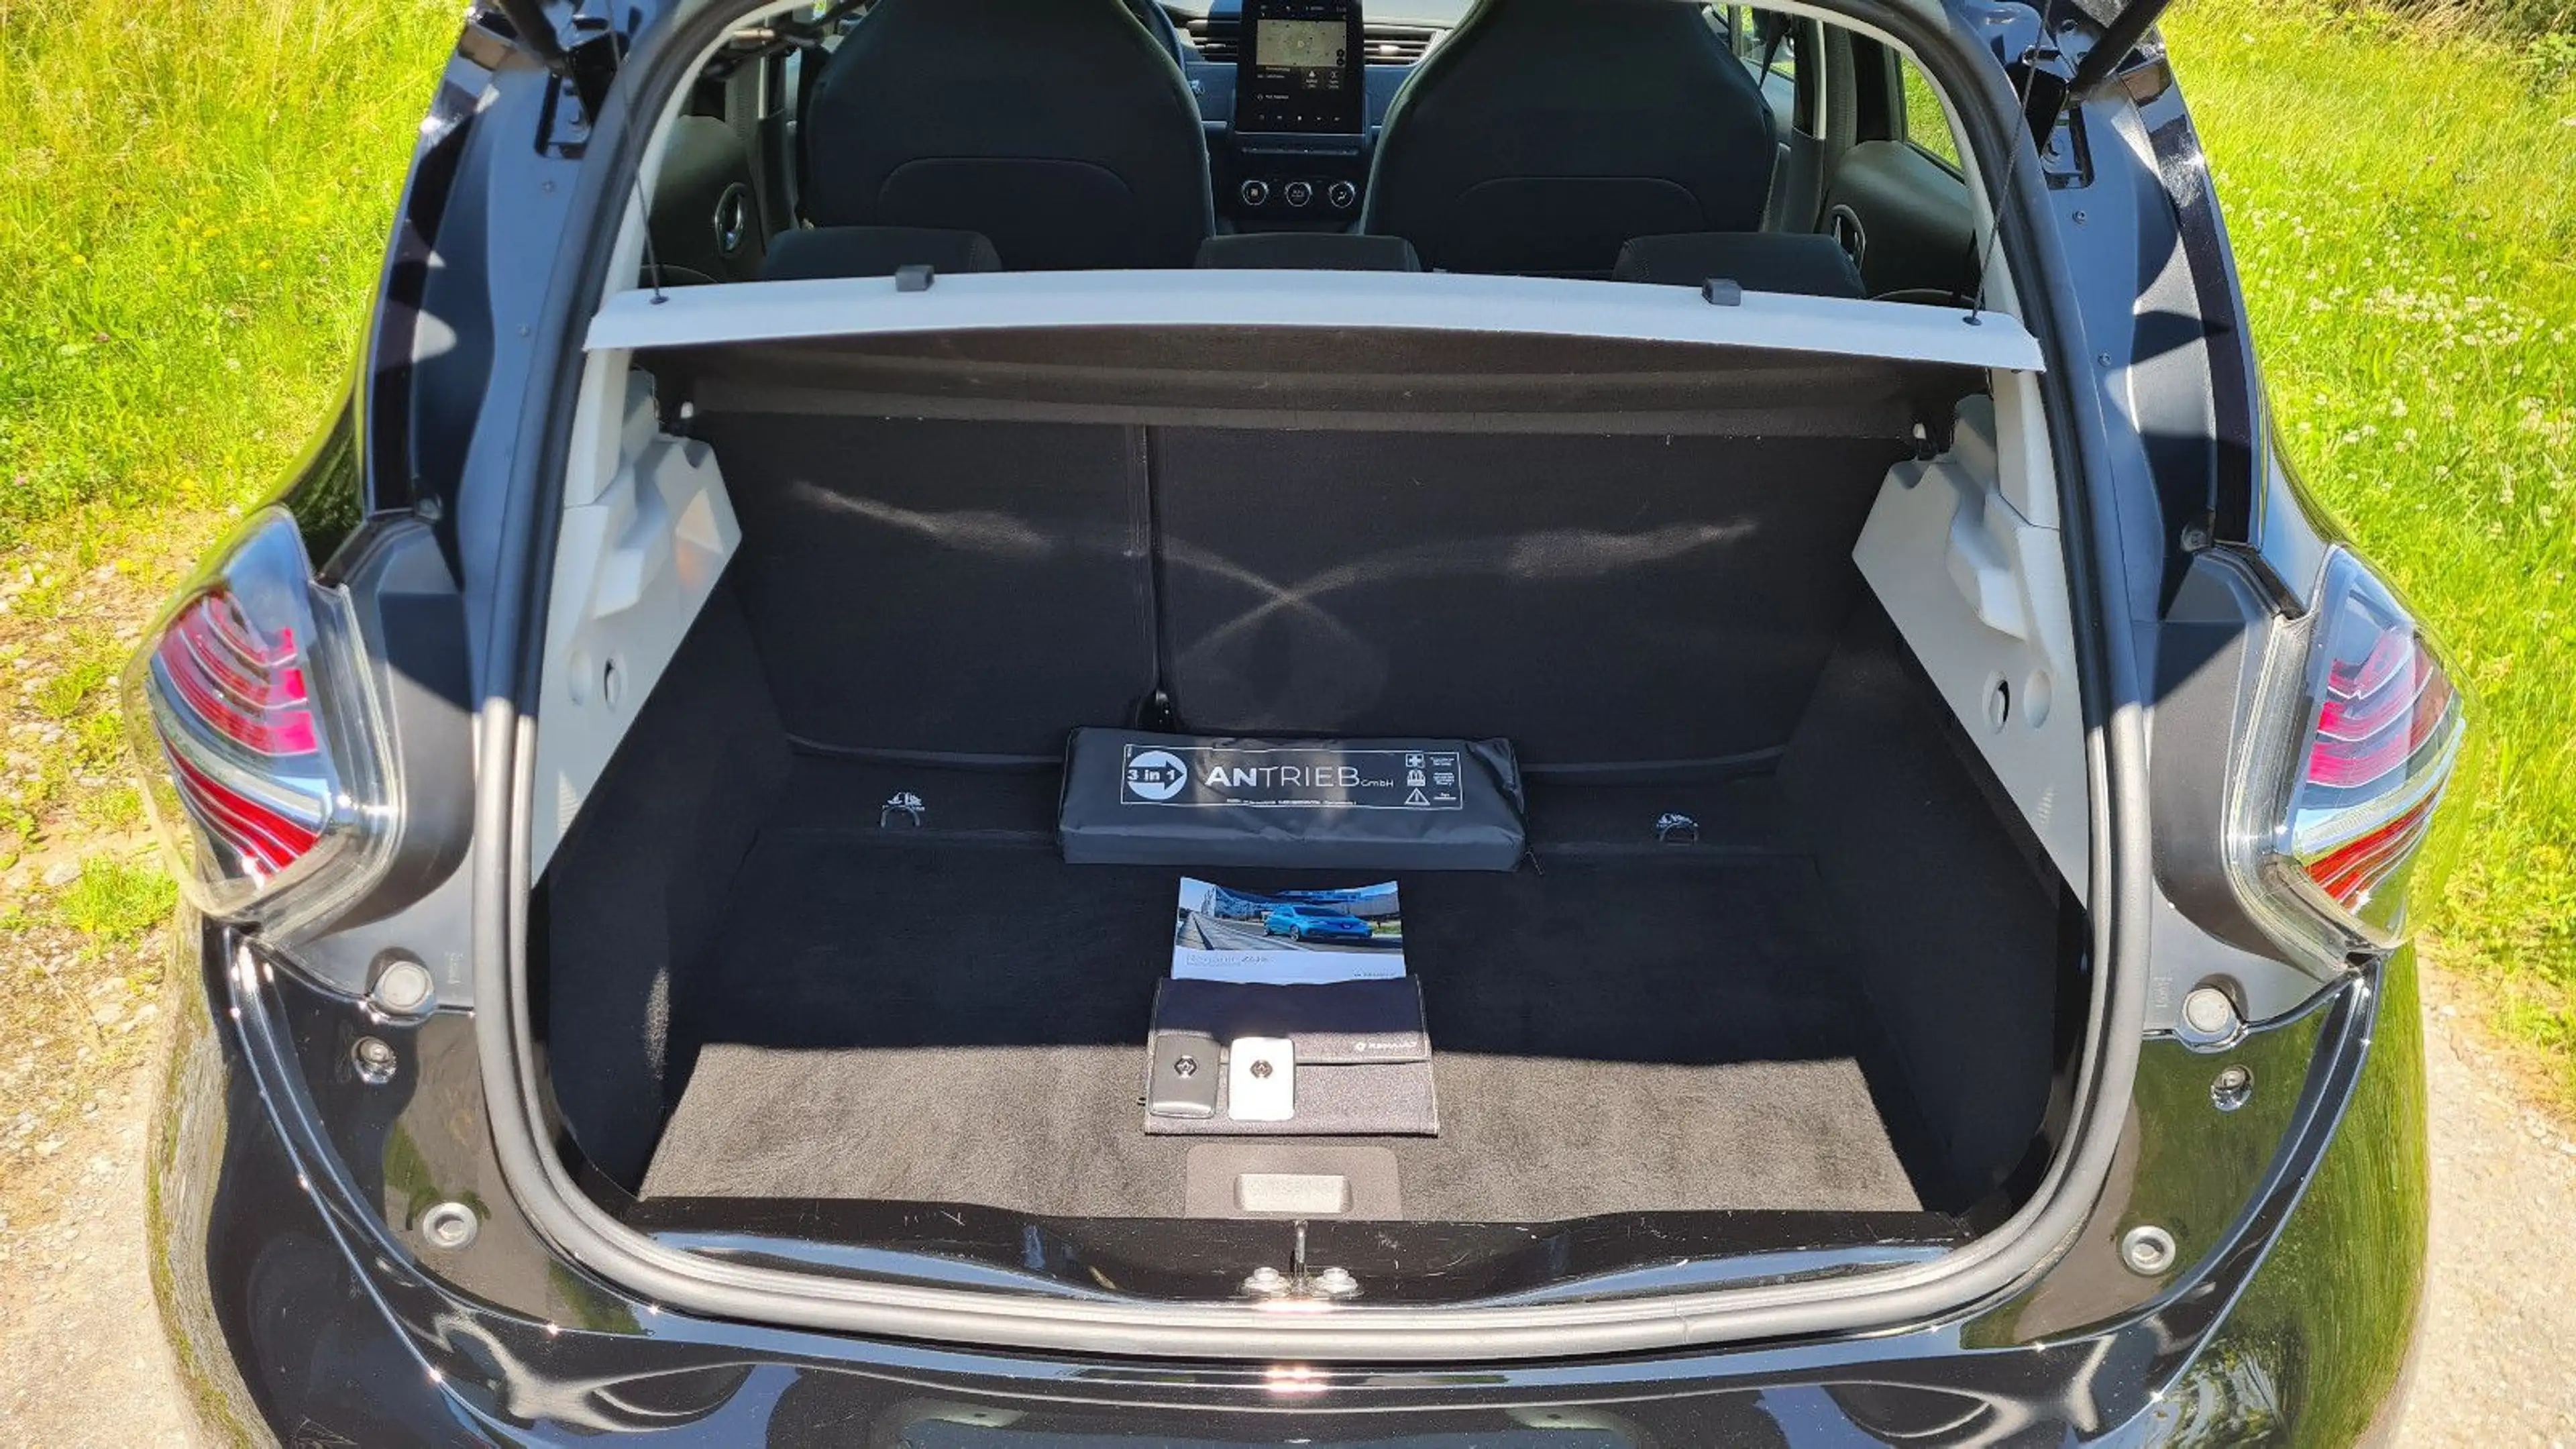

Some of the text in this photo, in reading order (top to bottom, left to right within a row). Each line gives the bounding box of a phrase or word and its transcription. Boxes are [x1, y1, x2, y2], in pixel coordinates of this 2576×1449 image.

[1126, 769, 1175, 782] 3 in 1
[1205, 765, 1394, 788] ANTRIEB GmbH
